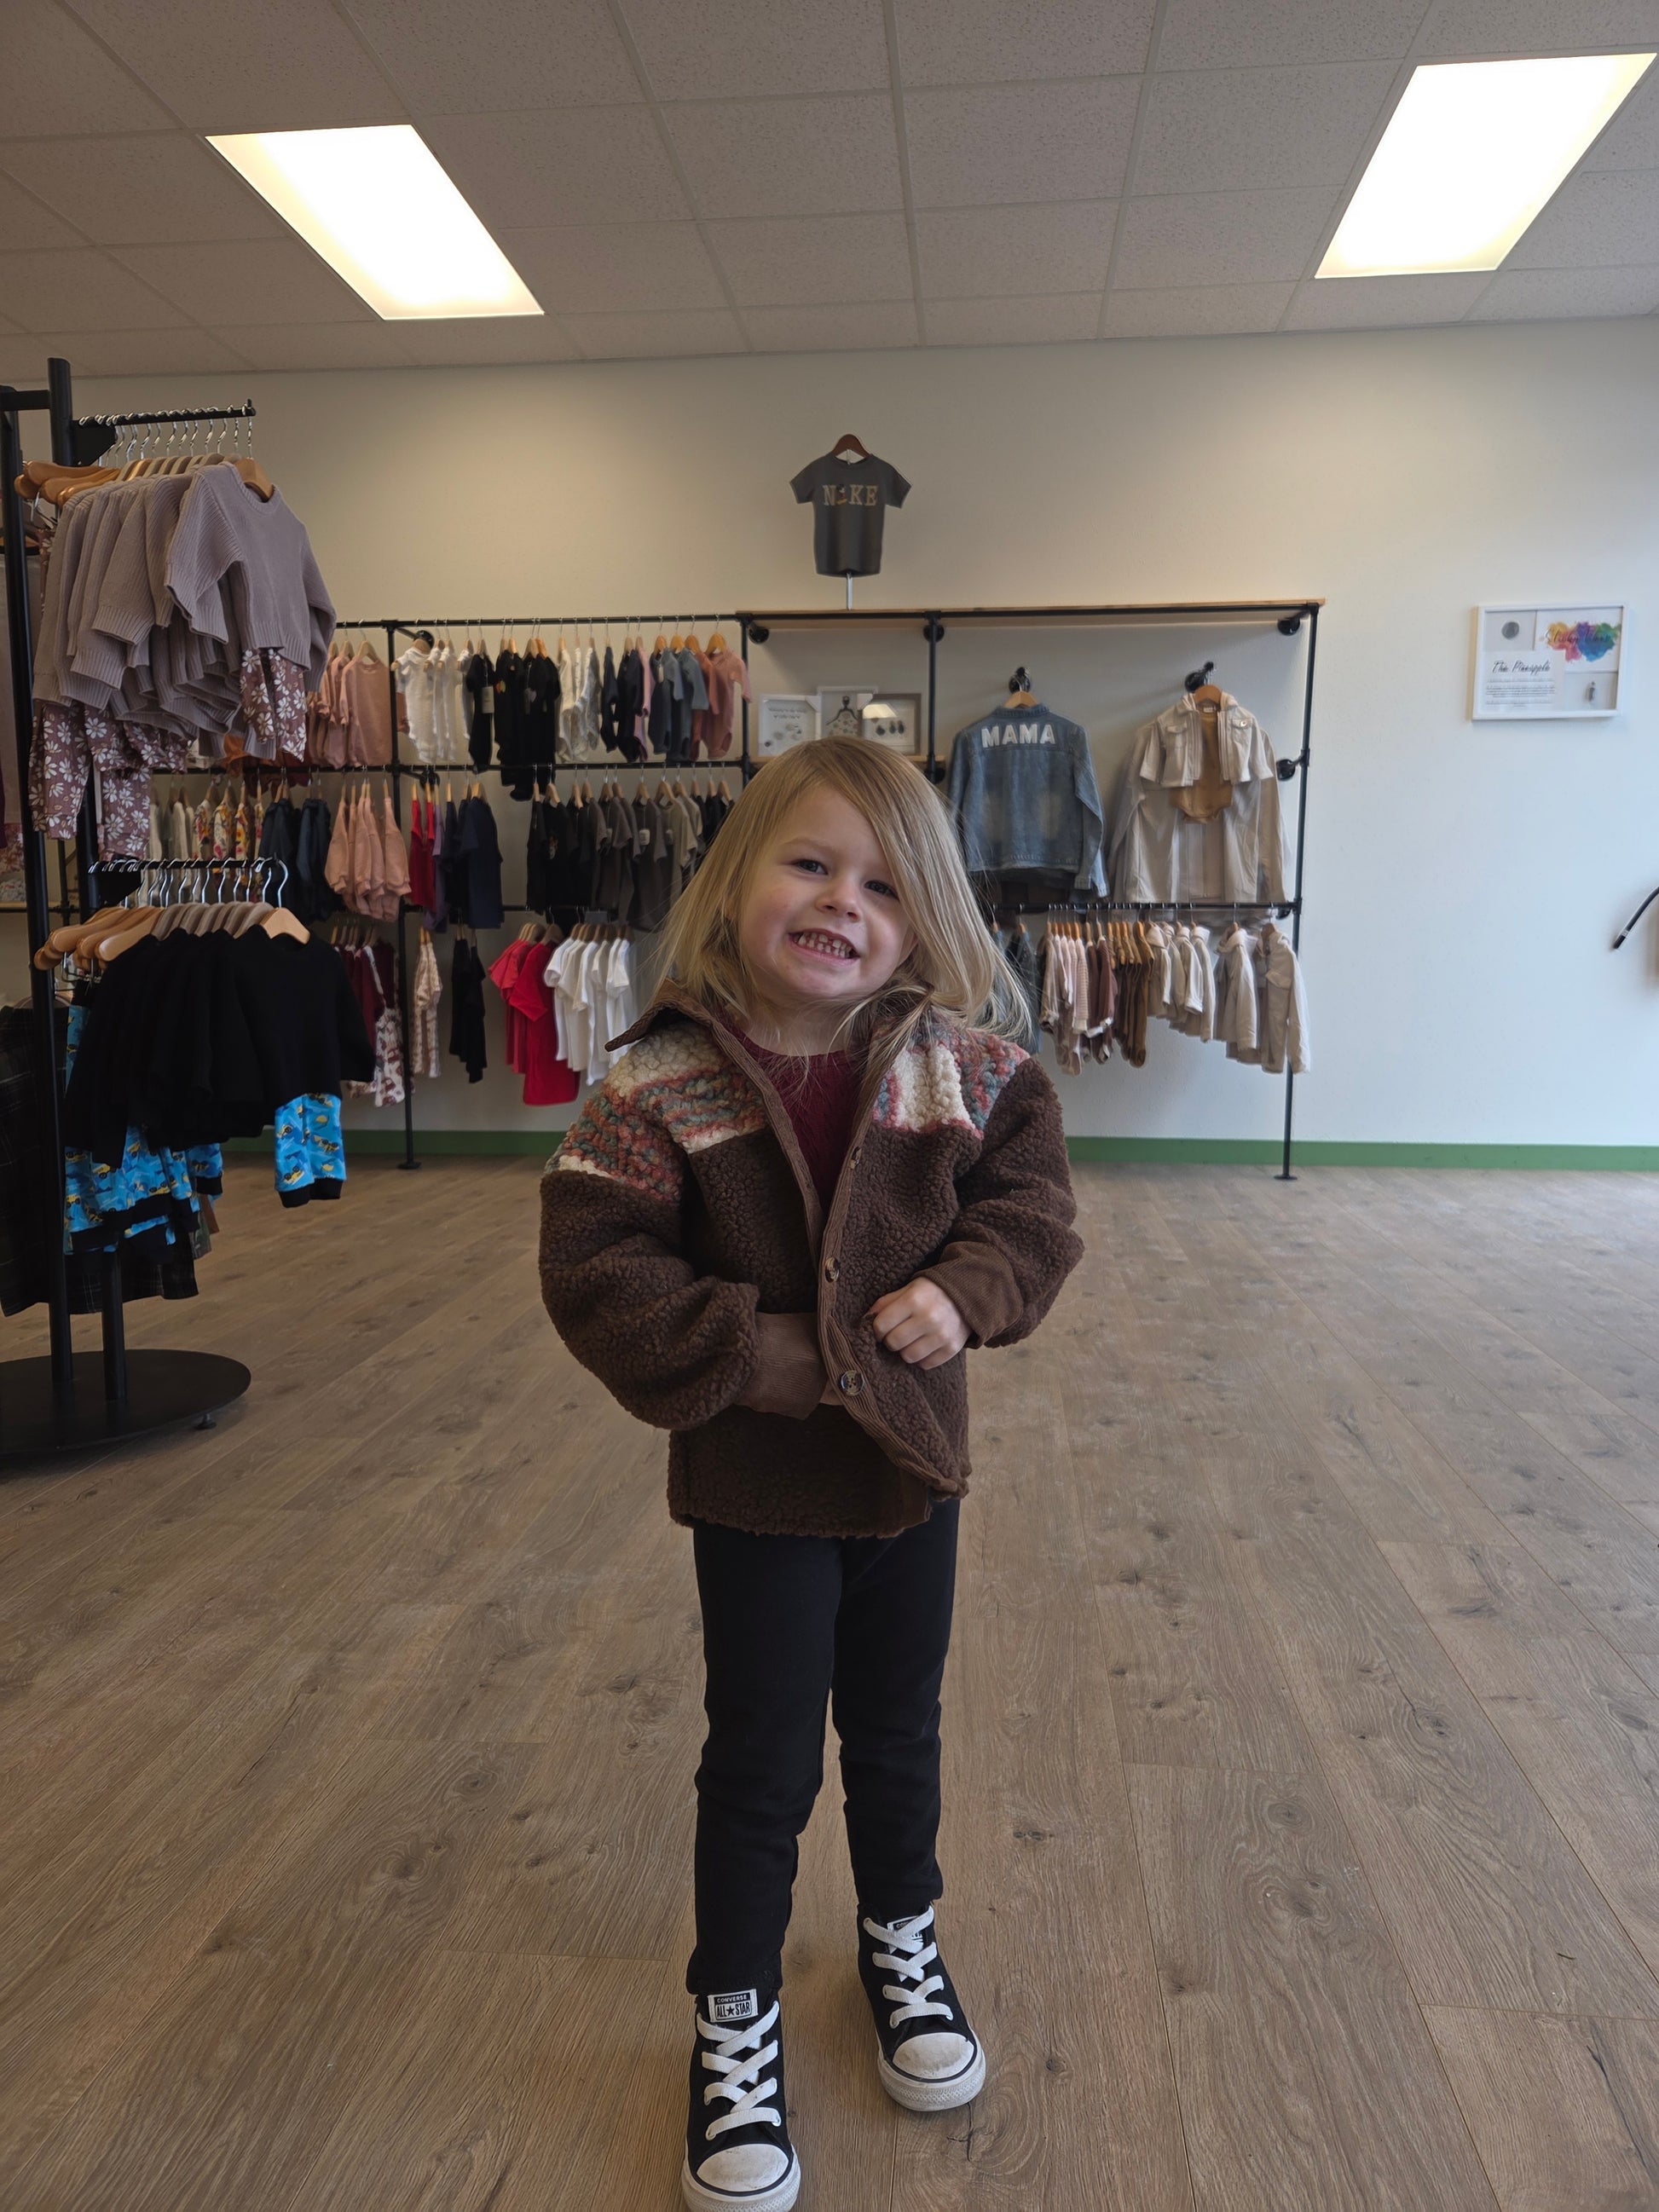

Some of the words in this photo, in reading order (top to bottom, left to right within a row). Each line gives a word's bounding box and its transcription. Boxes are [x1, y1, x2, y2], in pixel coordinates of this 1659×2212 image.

[823, 484, 879, 506] NKE
[1492, 660, 1509, 673] The
[981, 724, 1056, 748] MAMA
[717, 1995, 748, 2003] CONVERSE
[717, 2005, 726, 2018] ALL
[736, 2001, 750, 2016] STAR
